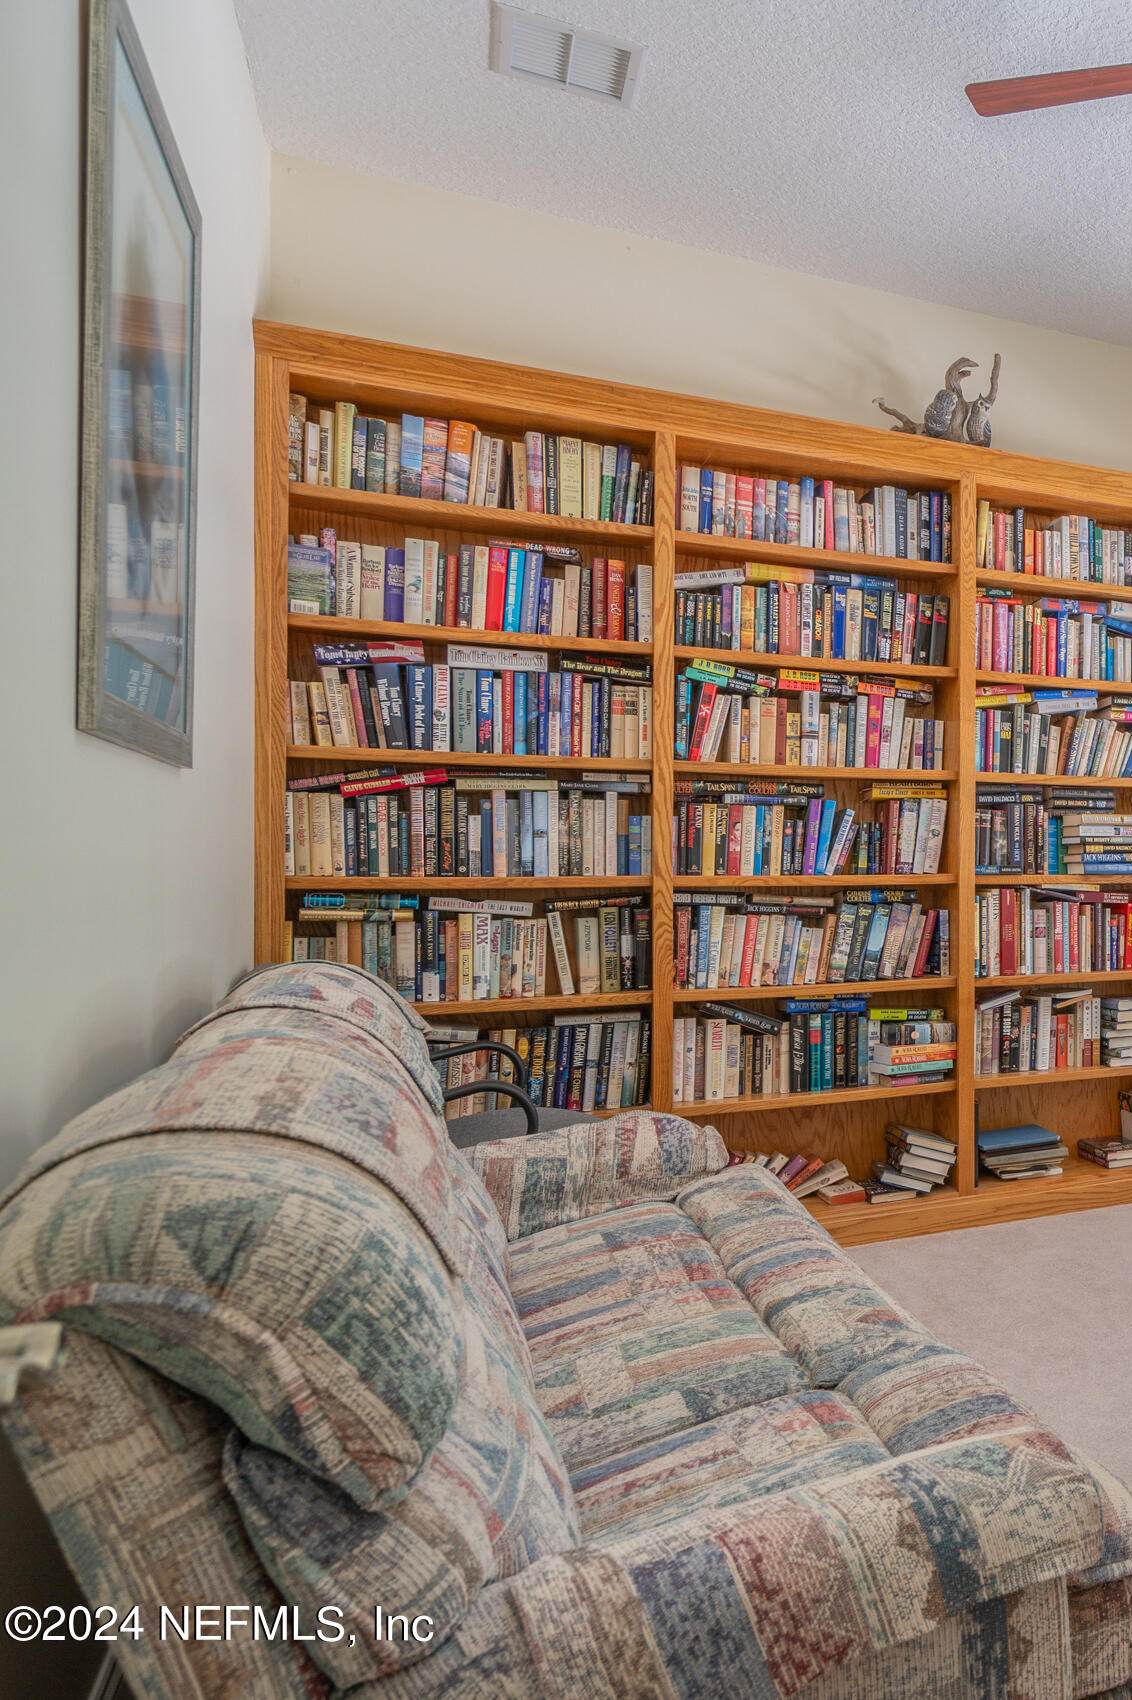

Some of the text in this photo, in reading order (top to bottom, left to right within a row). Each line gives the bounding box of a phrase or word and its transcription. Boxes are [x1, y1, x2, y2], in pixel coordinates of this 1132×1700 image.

[526, 543, 570, 555] DEAD WRONG
[346, 556, 355, 578] Woman
[346, 586, 356, 616] Substance
[451, 649, 465, 660] Tom
[466, 652, 496, 666] Clancy
[499, 652, 531, 666] Rainbow
[415, 668, 425, 680] Tom
[563, 661, 575, 669] The
[593, 664, 605, 672] and
[607, 666, 619, 674] The
[620, 667, 642, 679] Dragon
[376, 679, 388, 700] Without
[412, 682, 425, 702] Clancy
[438, 668, 448, 709] TOM CLANCY
[478, 677, 492, 714] Tom Clancy
[390, 687, 402, 717] Tom Clancy
[415, 705, 425, 719] Debt
[415, 728, 425, 747] Honor
[1068, 750, 1077, 769] SWAN
[343, 783, 362, 792] CLIVE
[706, 781, 736, 791] TAILSPIN
[790, 784, 817, 794] TAILSPIN
[377, 802, 386, 823] FEVER
[425, 810, 435, 835] CORNWELL
[426, 838, 436, 851] Point
[425, 859, 436, 874] Origin
[992, 893, 1000, 920] BIRDS
[476, 916, 488, 944] MAX
[604, 912, 616, 952] KEN FOLLETT
[491, 932, 500, 953] Legacy
[605, 957, 613, 980] FORTUNE
[576, 1028, 587, 1041] JOHN
[711, 1022, 723, 1051] SCARLETT
[534, 1042, 544, 1056] TIME
[573, 1042, 586, 1067] GRISHAM
[572, 1079, 581, 1101] CHAMBER
